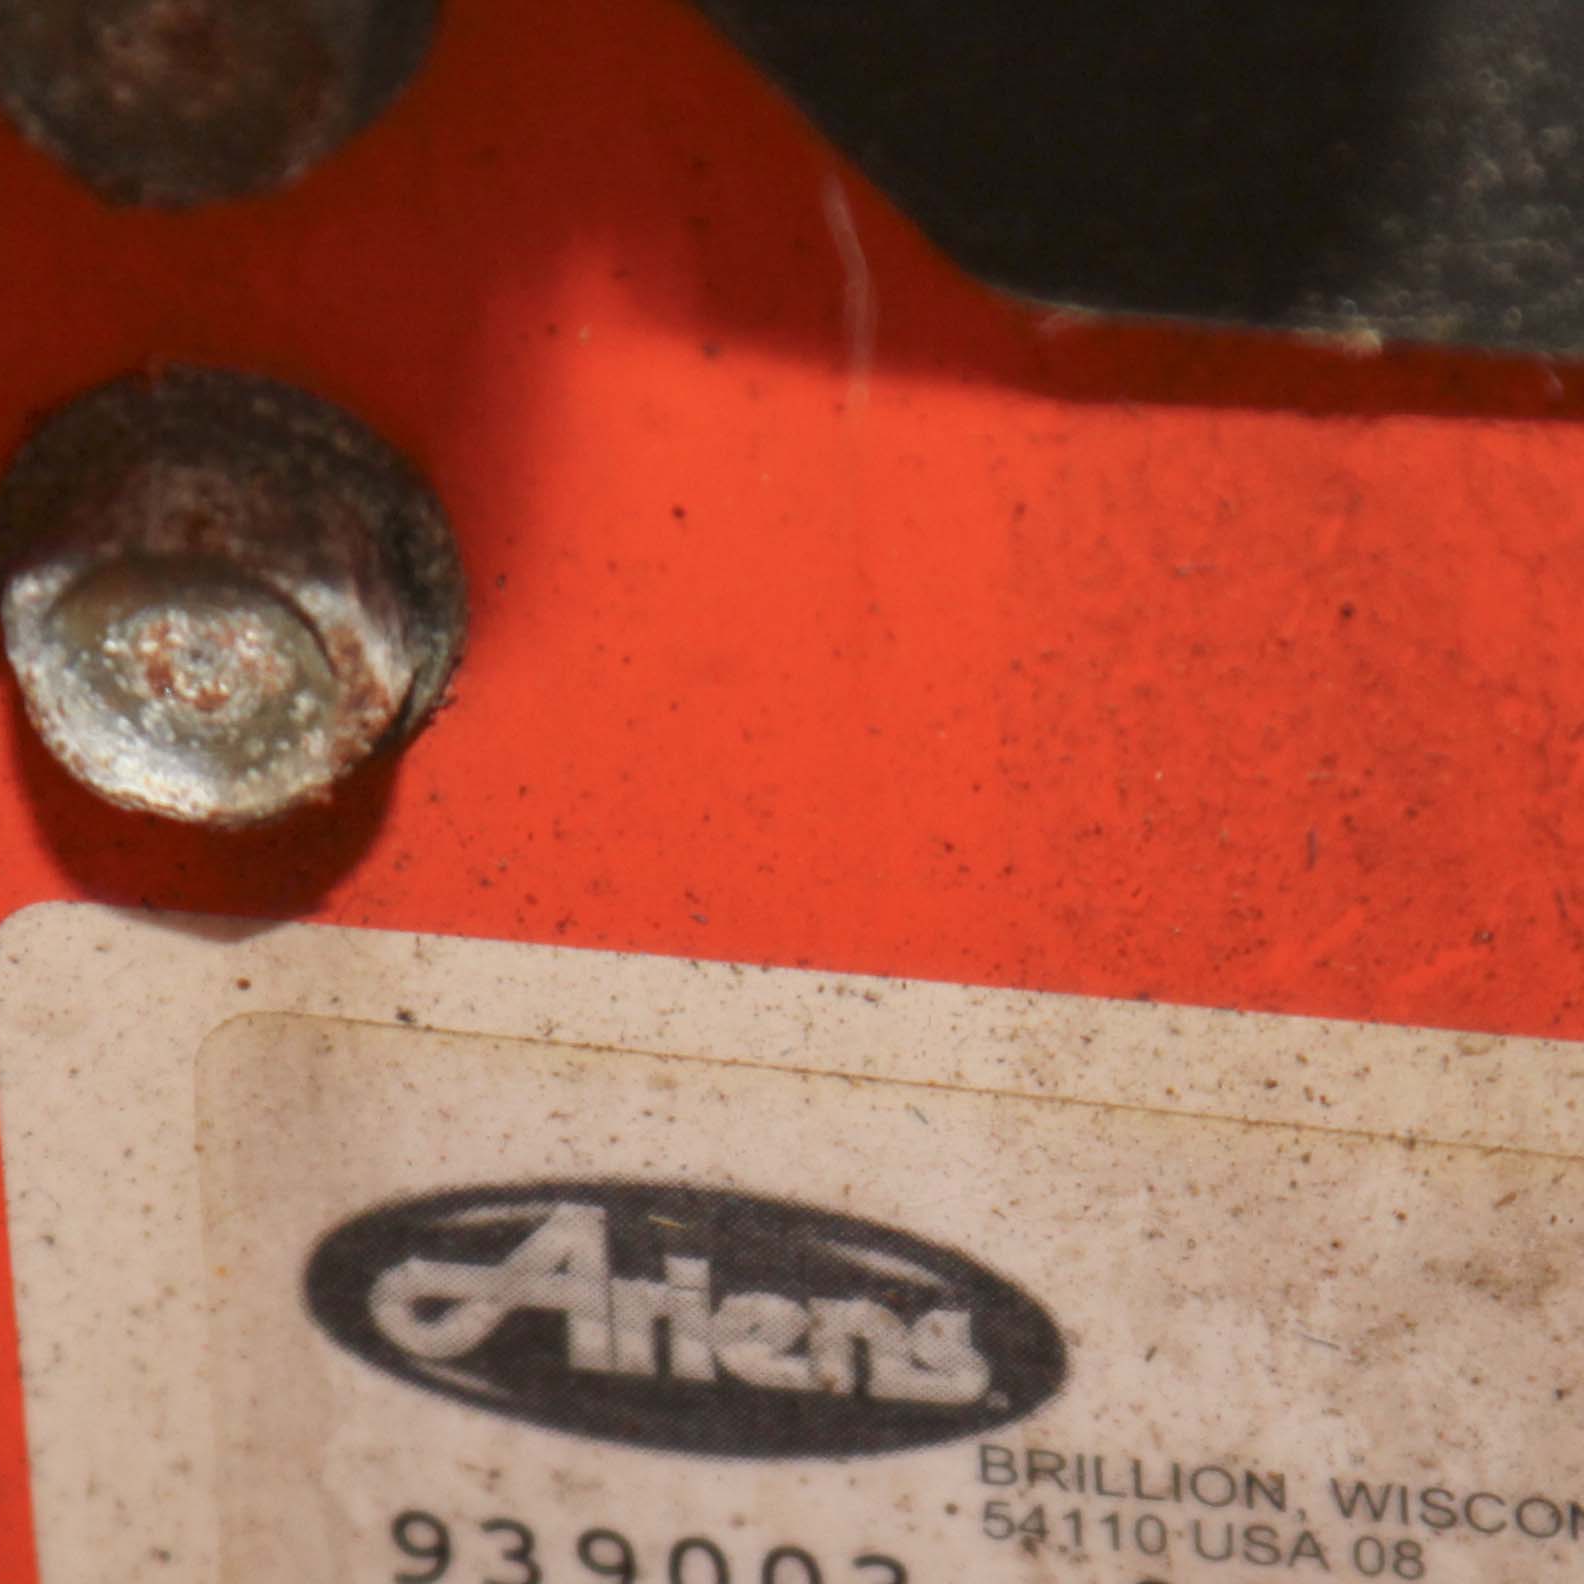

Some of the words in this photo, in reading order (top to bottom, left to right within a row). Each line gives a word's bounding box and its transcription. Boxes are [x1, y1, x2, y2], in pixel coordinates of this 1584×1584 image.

[368, 1200, 992, 1402] Ariens
[978, 1444, 1308, 1523] BRILLION,
[980, 1500, 1169, 1557] 54110
[1193, 1524, 1328, 1571] USA
[1352, 1536, 1426, 1581] 08
